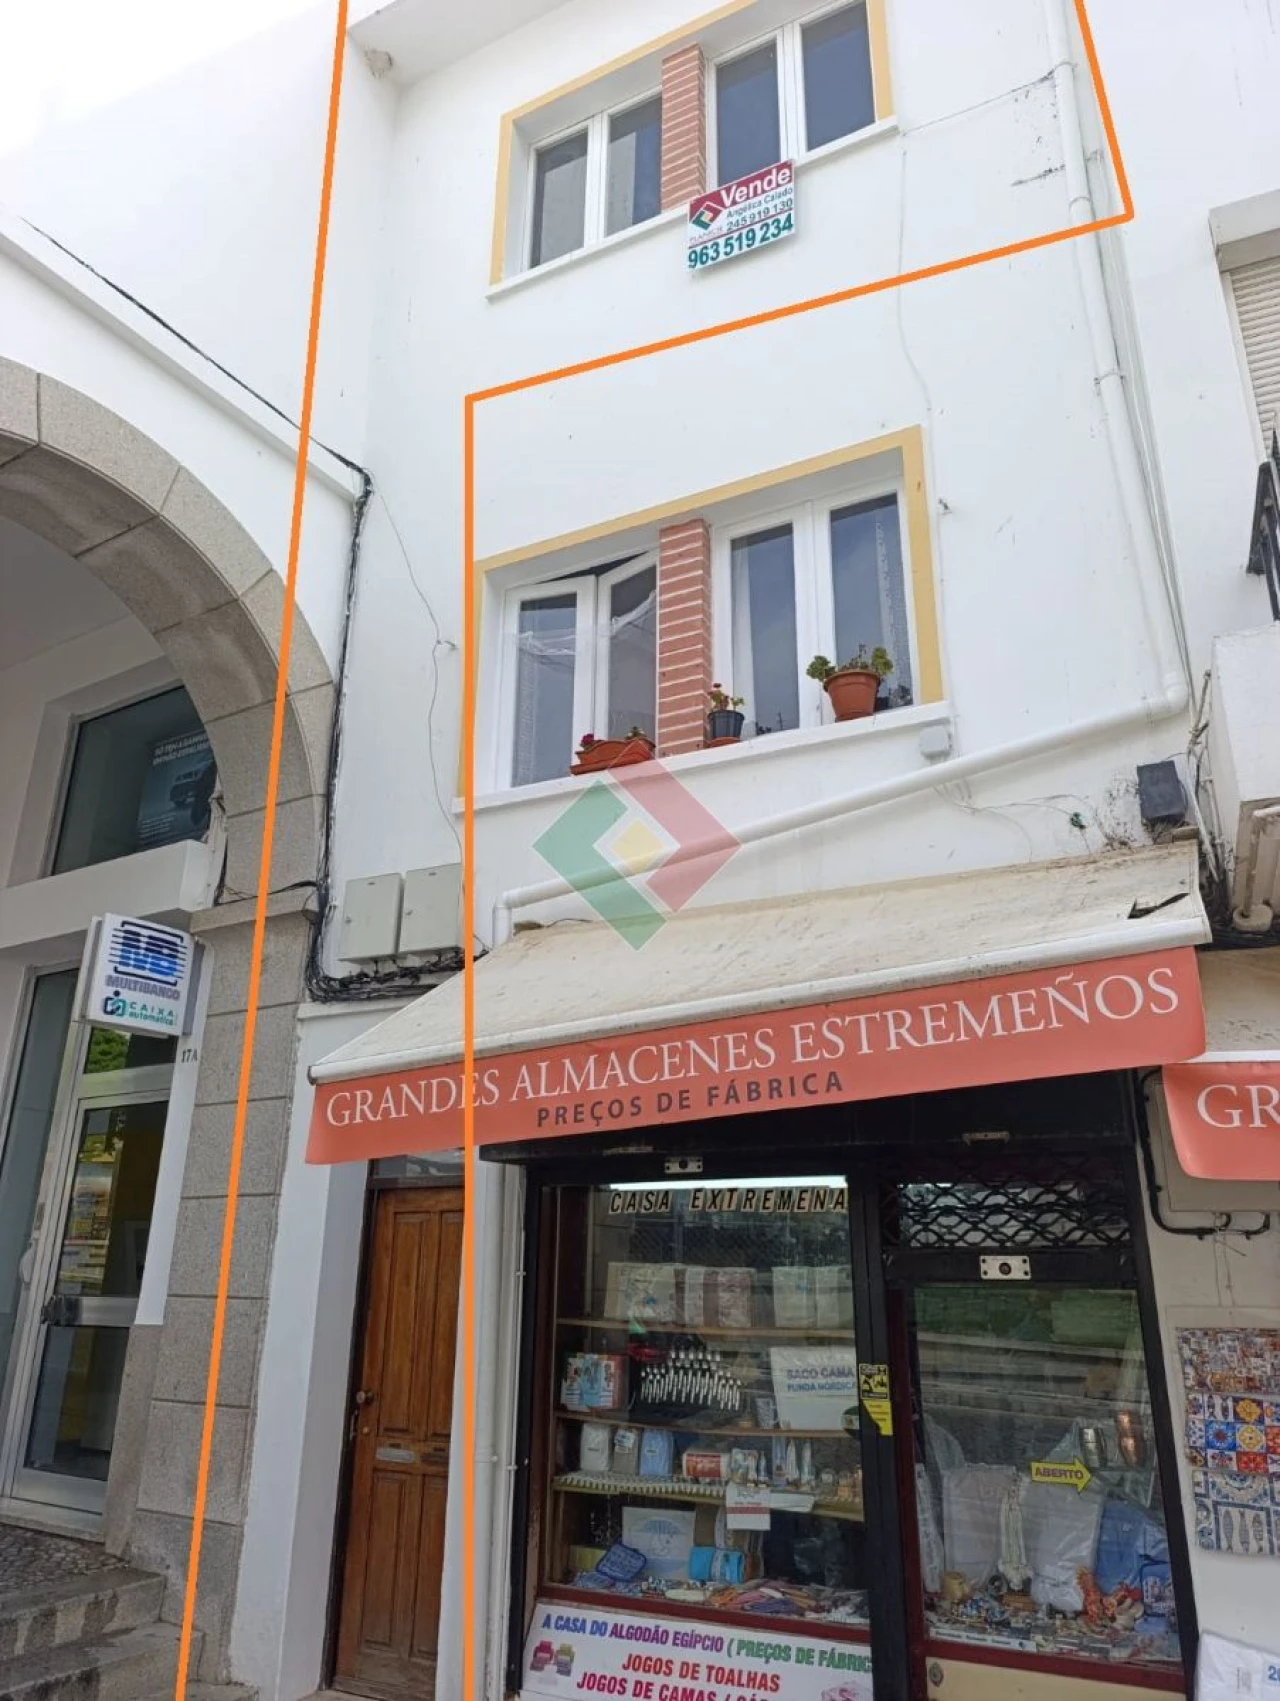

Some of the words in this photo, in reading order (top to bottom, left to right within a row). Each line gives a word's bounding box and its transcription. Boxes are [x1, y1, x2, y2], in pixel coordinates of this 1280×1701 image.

[720, 168, 791, 208] Vende
[764, 187, 793, 205] Calado
[726, 217, 748, 232] 245
[749, 206, 771, 223] 919
[773, 199, 793, 214] 130
[688, 242, 720, 269] 963
[724, 227, 756, 257] 519
[760, 213, 793, 243] 234
[105, 974, 181, 1000] MULTIBANCO
[181, 1048, 198, 1063] 17A
[326, 1069, 500, 1128] GRANDES
[509, 1027, 776, 1102] ALMACENES
[791, 966, 1180, 1063] ESTREMEÑOS
[537, 1096, 642, 1128] PREÇOS
[657, 1089, 691, 1114] DE
[707, 1071, 843, 1107] FÁBRICA
[1197, 1084, 1280, 1128] GR
[610, 1190, 670, 1212] CASA
[691, 1187, 846, 1211] EXTREMENA
[787, 1367, 818, 1380] SACO
[820, 1366, 855, 1379] CAMA
[1035, 1466, 1084, 1480] ABERTO
[542, 1613, 552, 1629] A
[554, 1615, 586, 1634] CASA
[589, 1620, 608, 1636] DO
[609, 1622, 669, 1645] ALGODÃO
[672, 1628, 724, 1657] EGÍPCIO
[736, 1639, 792, 1664] PREÇOS
[795, 1646, 816, 1666] DE
[576, 1671, 628, 1696] JOGOS
[632, 1679, 654, 1699] DE
[622, 1653, 674, 1677] JOGOS
[679, 1660, 701, 1681] DE
[706, 1664, 781, 1693] TOALHAS
